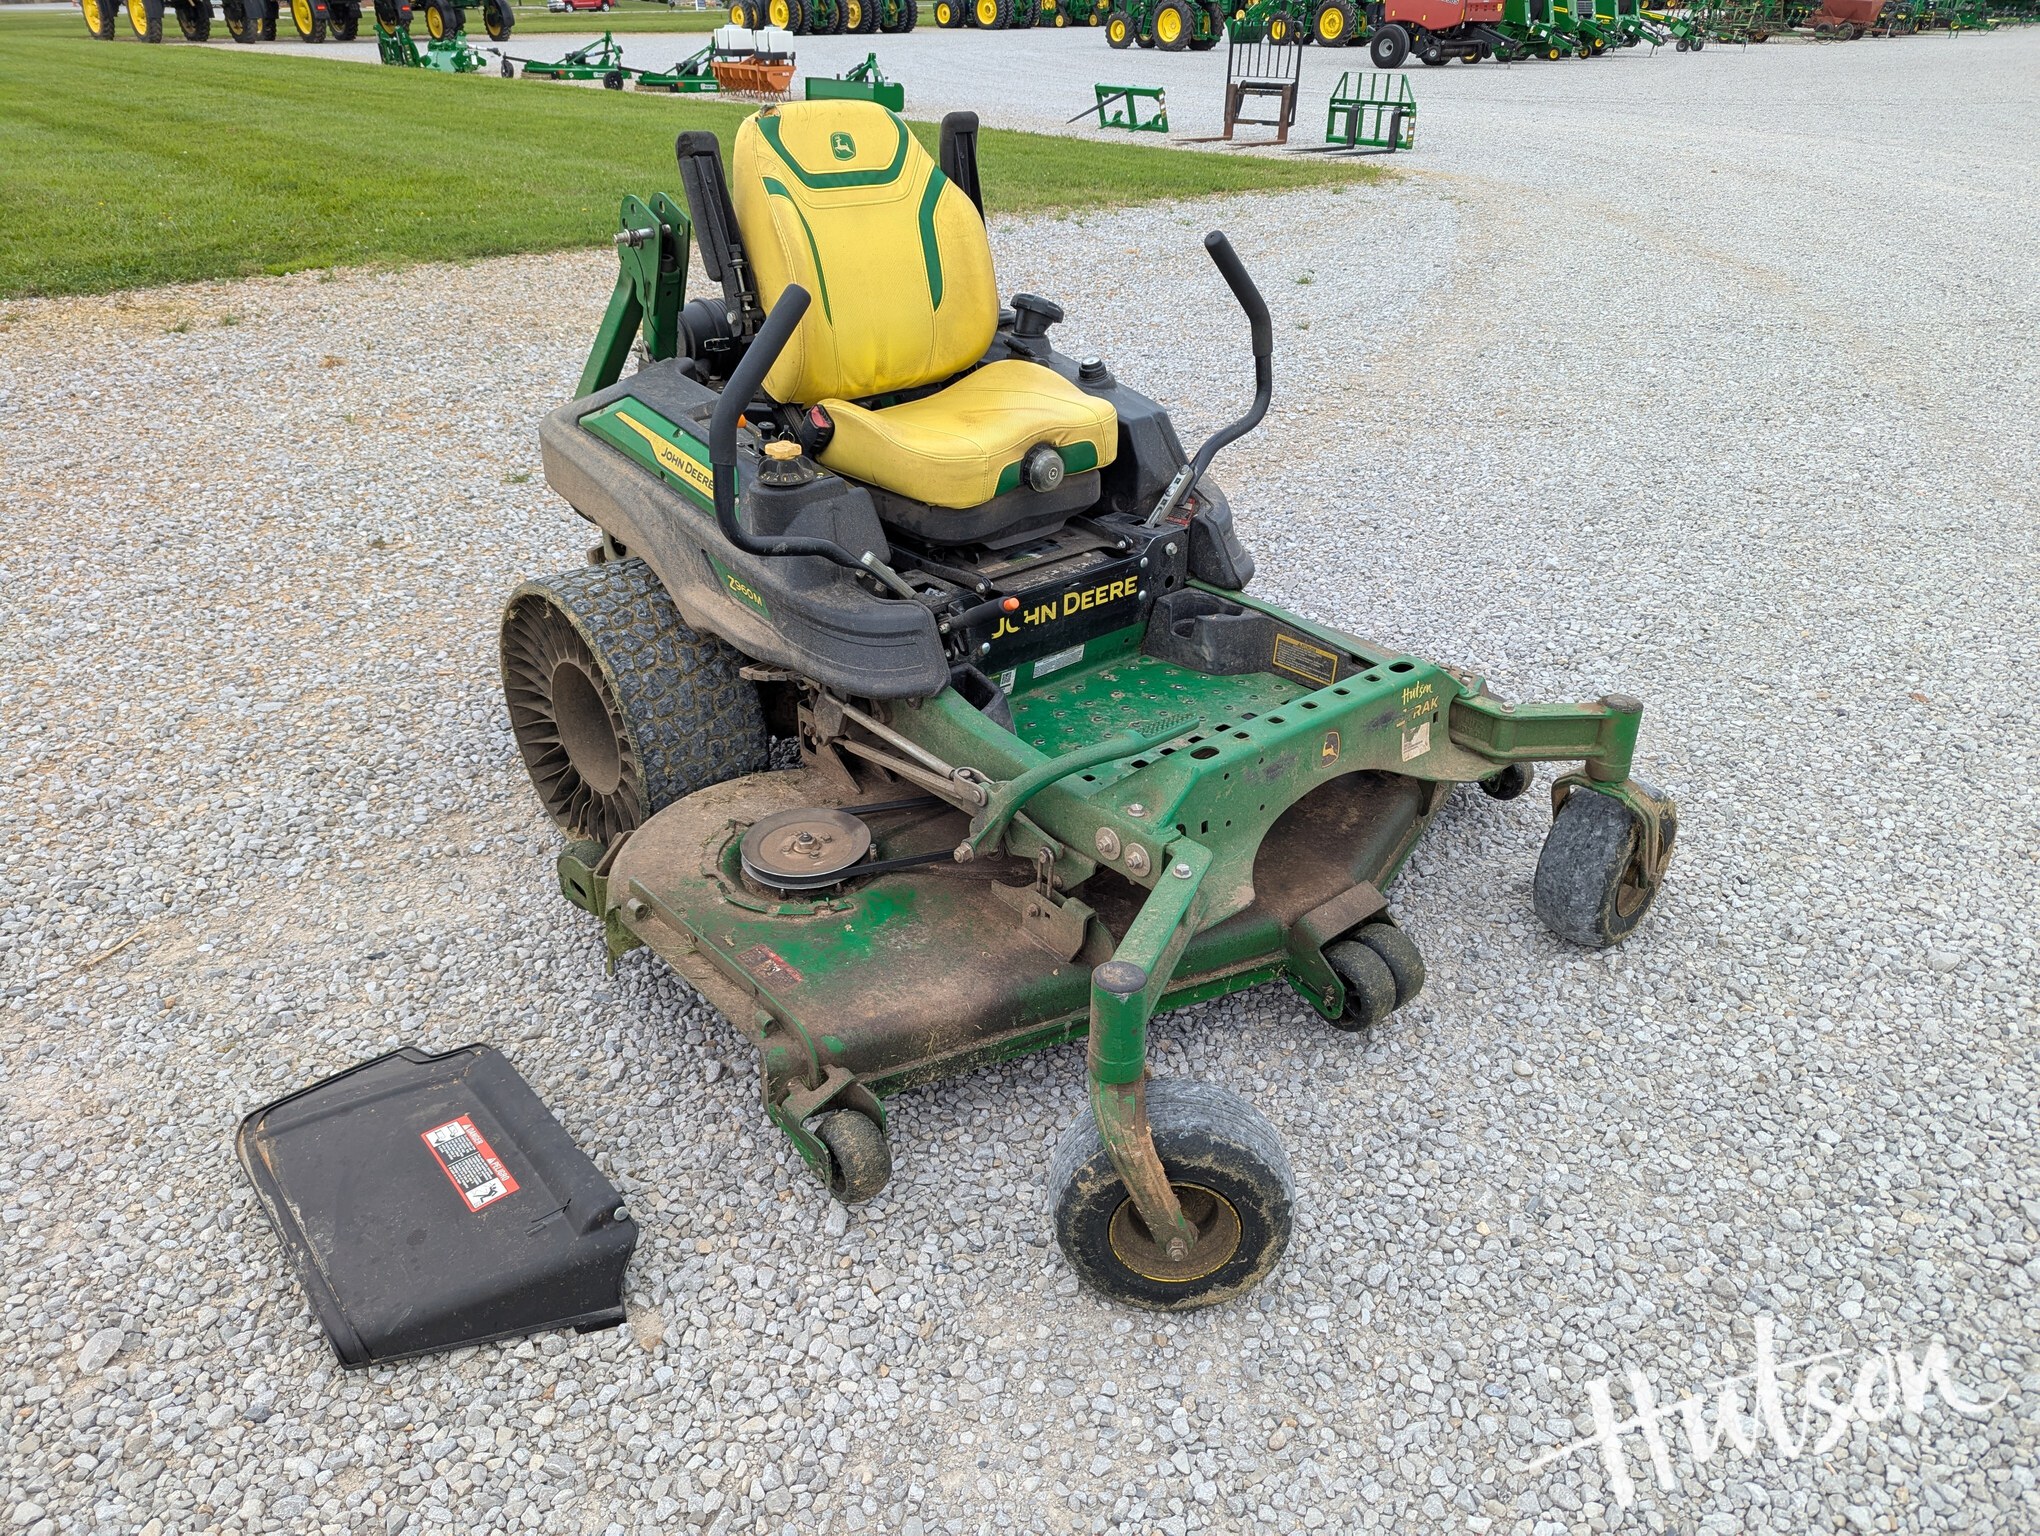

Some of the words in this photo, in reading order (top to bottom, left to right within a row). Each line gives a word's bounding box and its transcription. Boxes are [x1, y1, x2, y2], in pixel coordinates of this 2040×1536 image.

[661, 447, 685, 470] JOHN
[727, 574, 763, 607] Z960M
[1063, 575, 1138, 616] DEERE
[1401, 680, 1433, 706] Hutson
[466, 1127, 484, 1146] DANGER
[490, 1161, 510, 1181] PELIGRO
